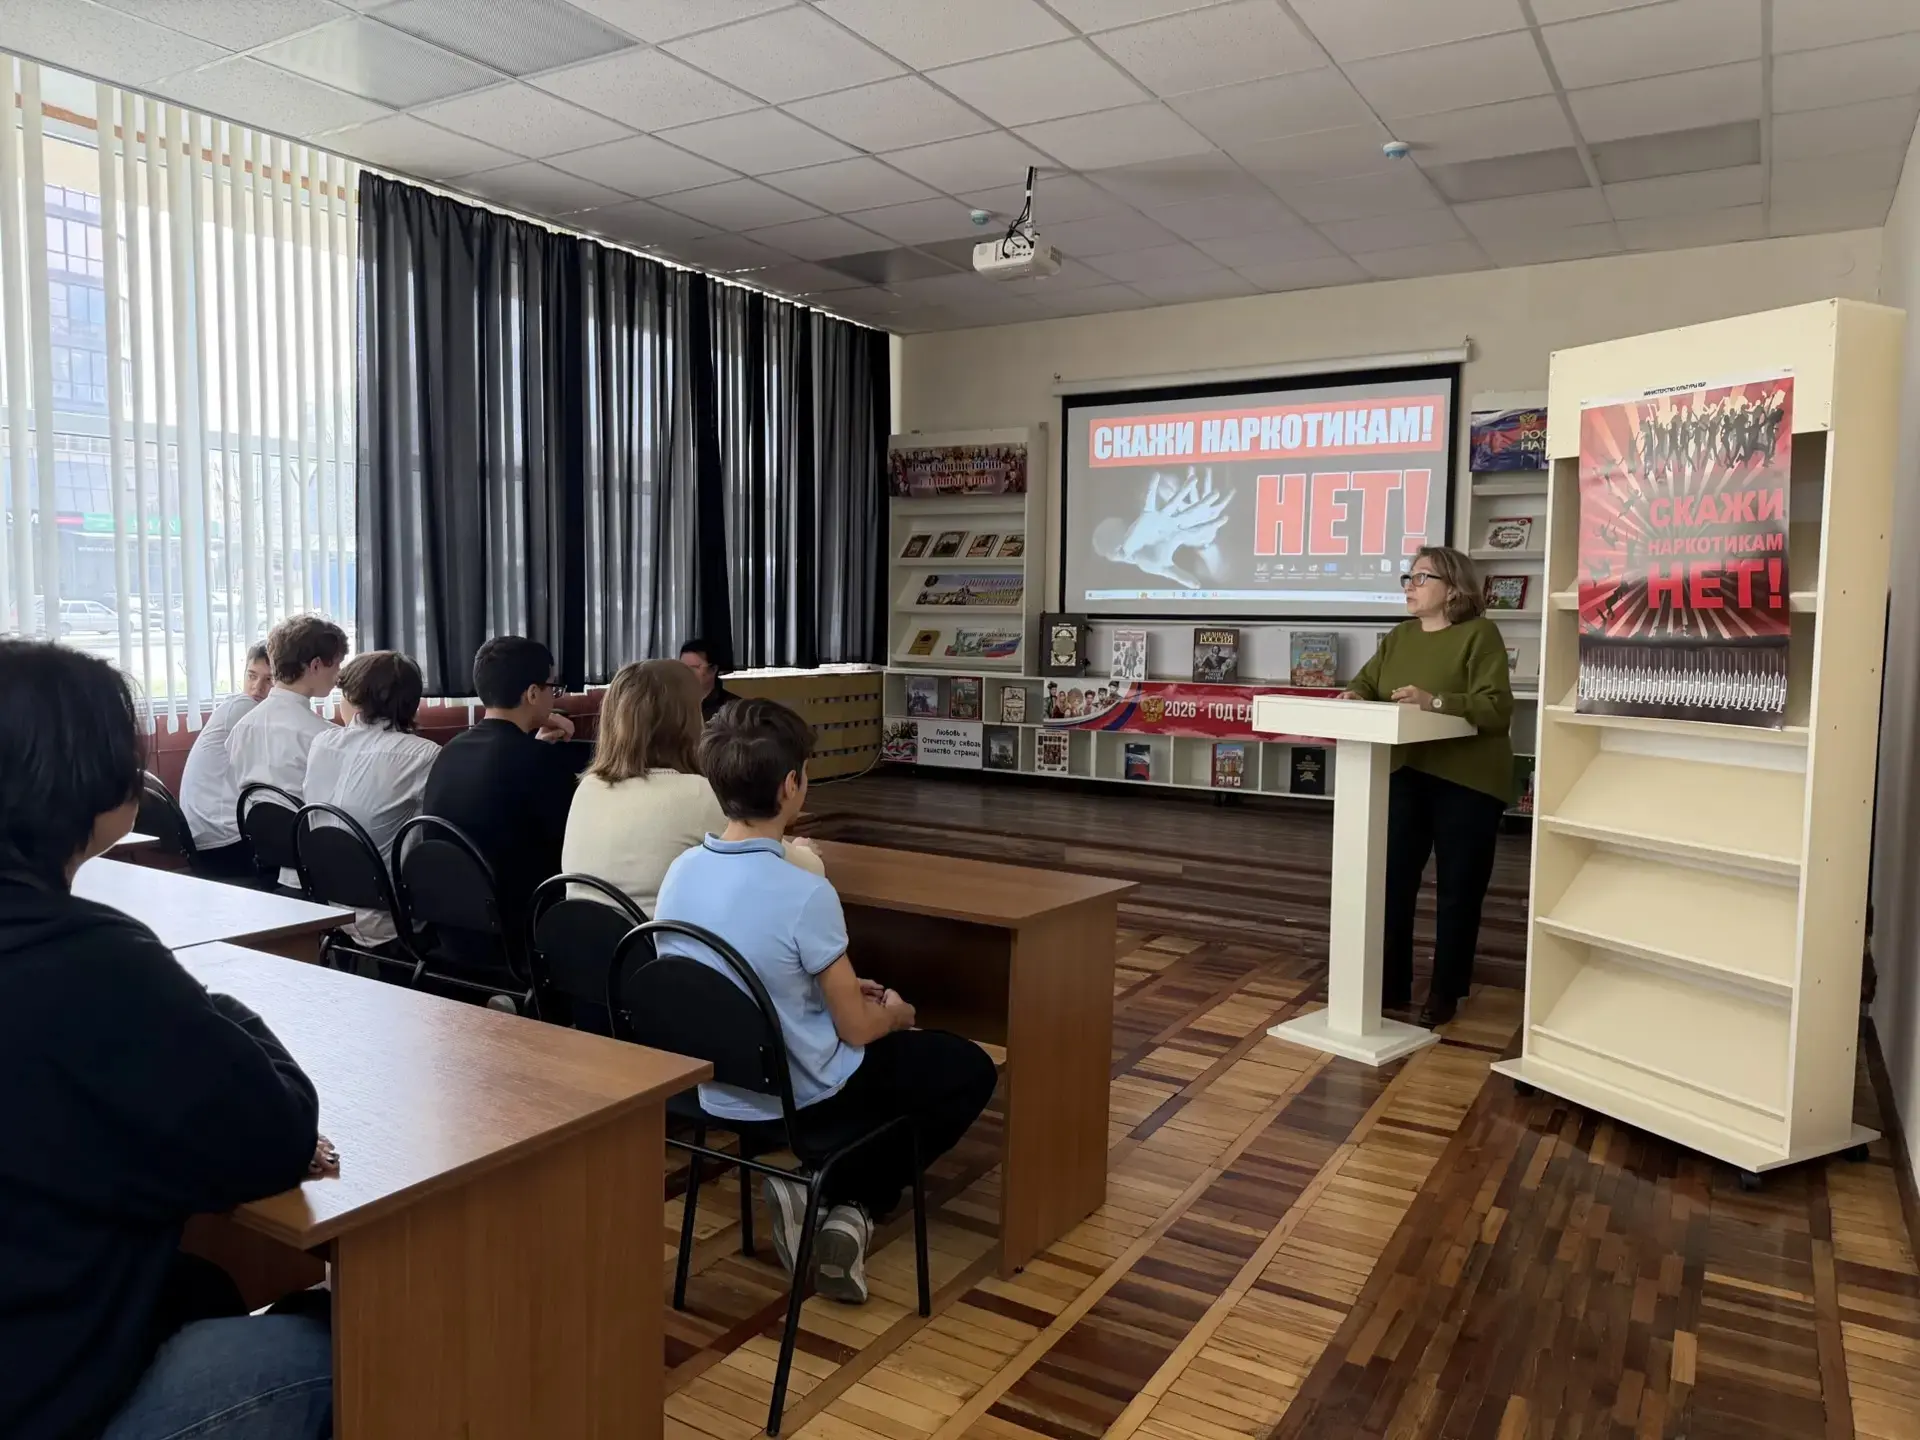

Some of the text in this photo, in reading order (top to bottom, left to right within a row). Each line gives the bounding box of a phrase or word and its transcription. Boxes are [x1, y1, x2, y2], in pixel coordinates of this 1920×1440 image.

[1094, 405, 1435, 459] СКАЖИ НАРКОТИКАМ!
[1254, 469, 1432, 556] НЕТ!
[1650, 488, 1784, 527] СКАЖИ
[1648, 533, 1784, 556] НАРКОТИКАМ
[1647, 557, 1782, 609] НЕТ!
[1199, 634, 1234, 644] РОССИЯ
[1165, 701, 1196, 718] 2026
[1208, 703, 1234, 721] ГОД
[936, 728, 961, 737] Любовь
[959, 740, 981, 748] сквозь
